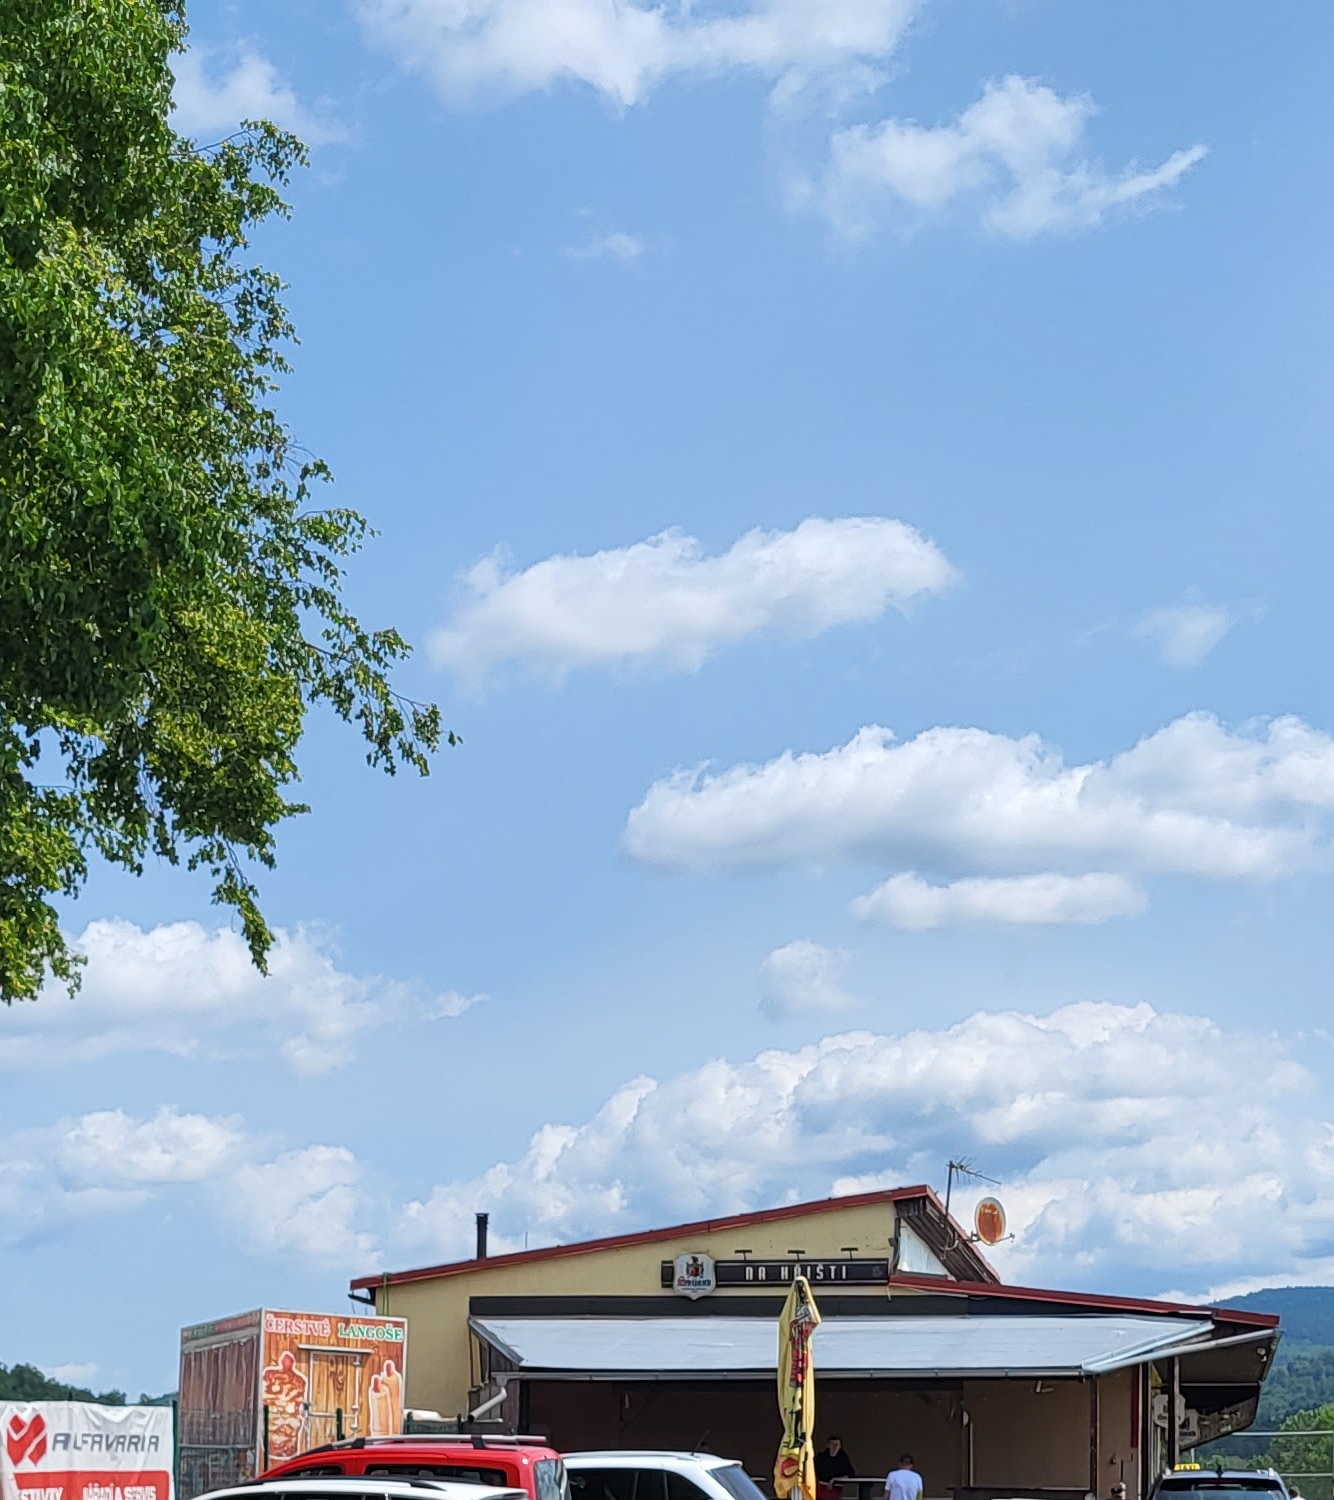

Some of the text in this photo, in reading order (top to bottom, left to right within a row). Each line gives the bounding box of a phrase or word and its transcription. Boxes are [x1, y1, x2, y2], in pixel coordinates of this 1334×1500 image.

[745, 1266, 766, 1281] NA
[265, 1314, 331, 1337] ČERSTVÉ
[338, 1323, 404, 1342] LANGOŠE
